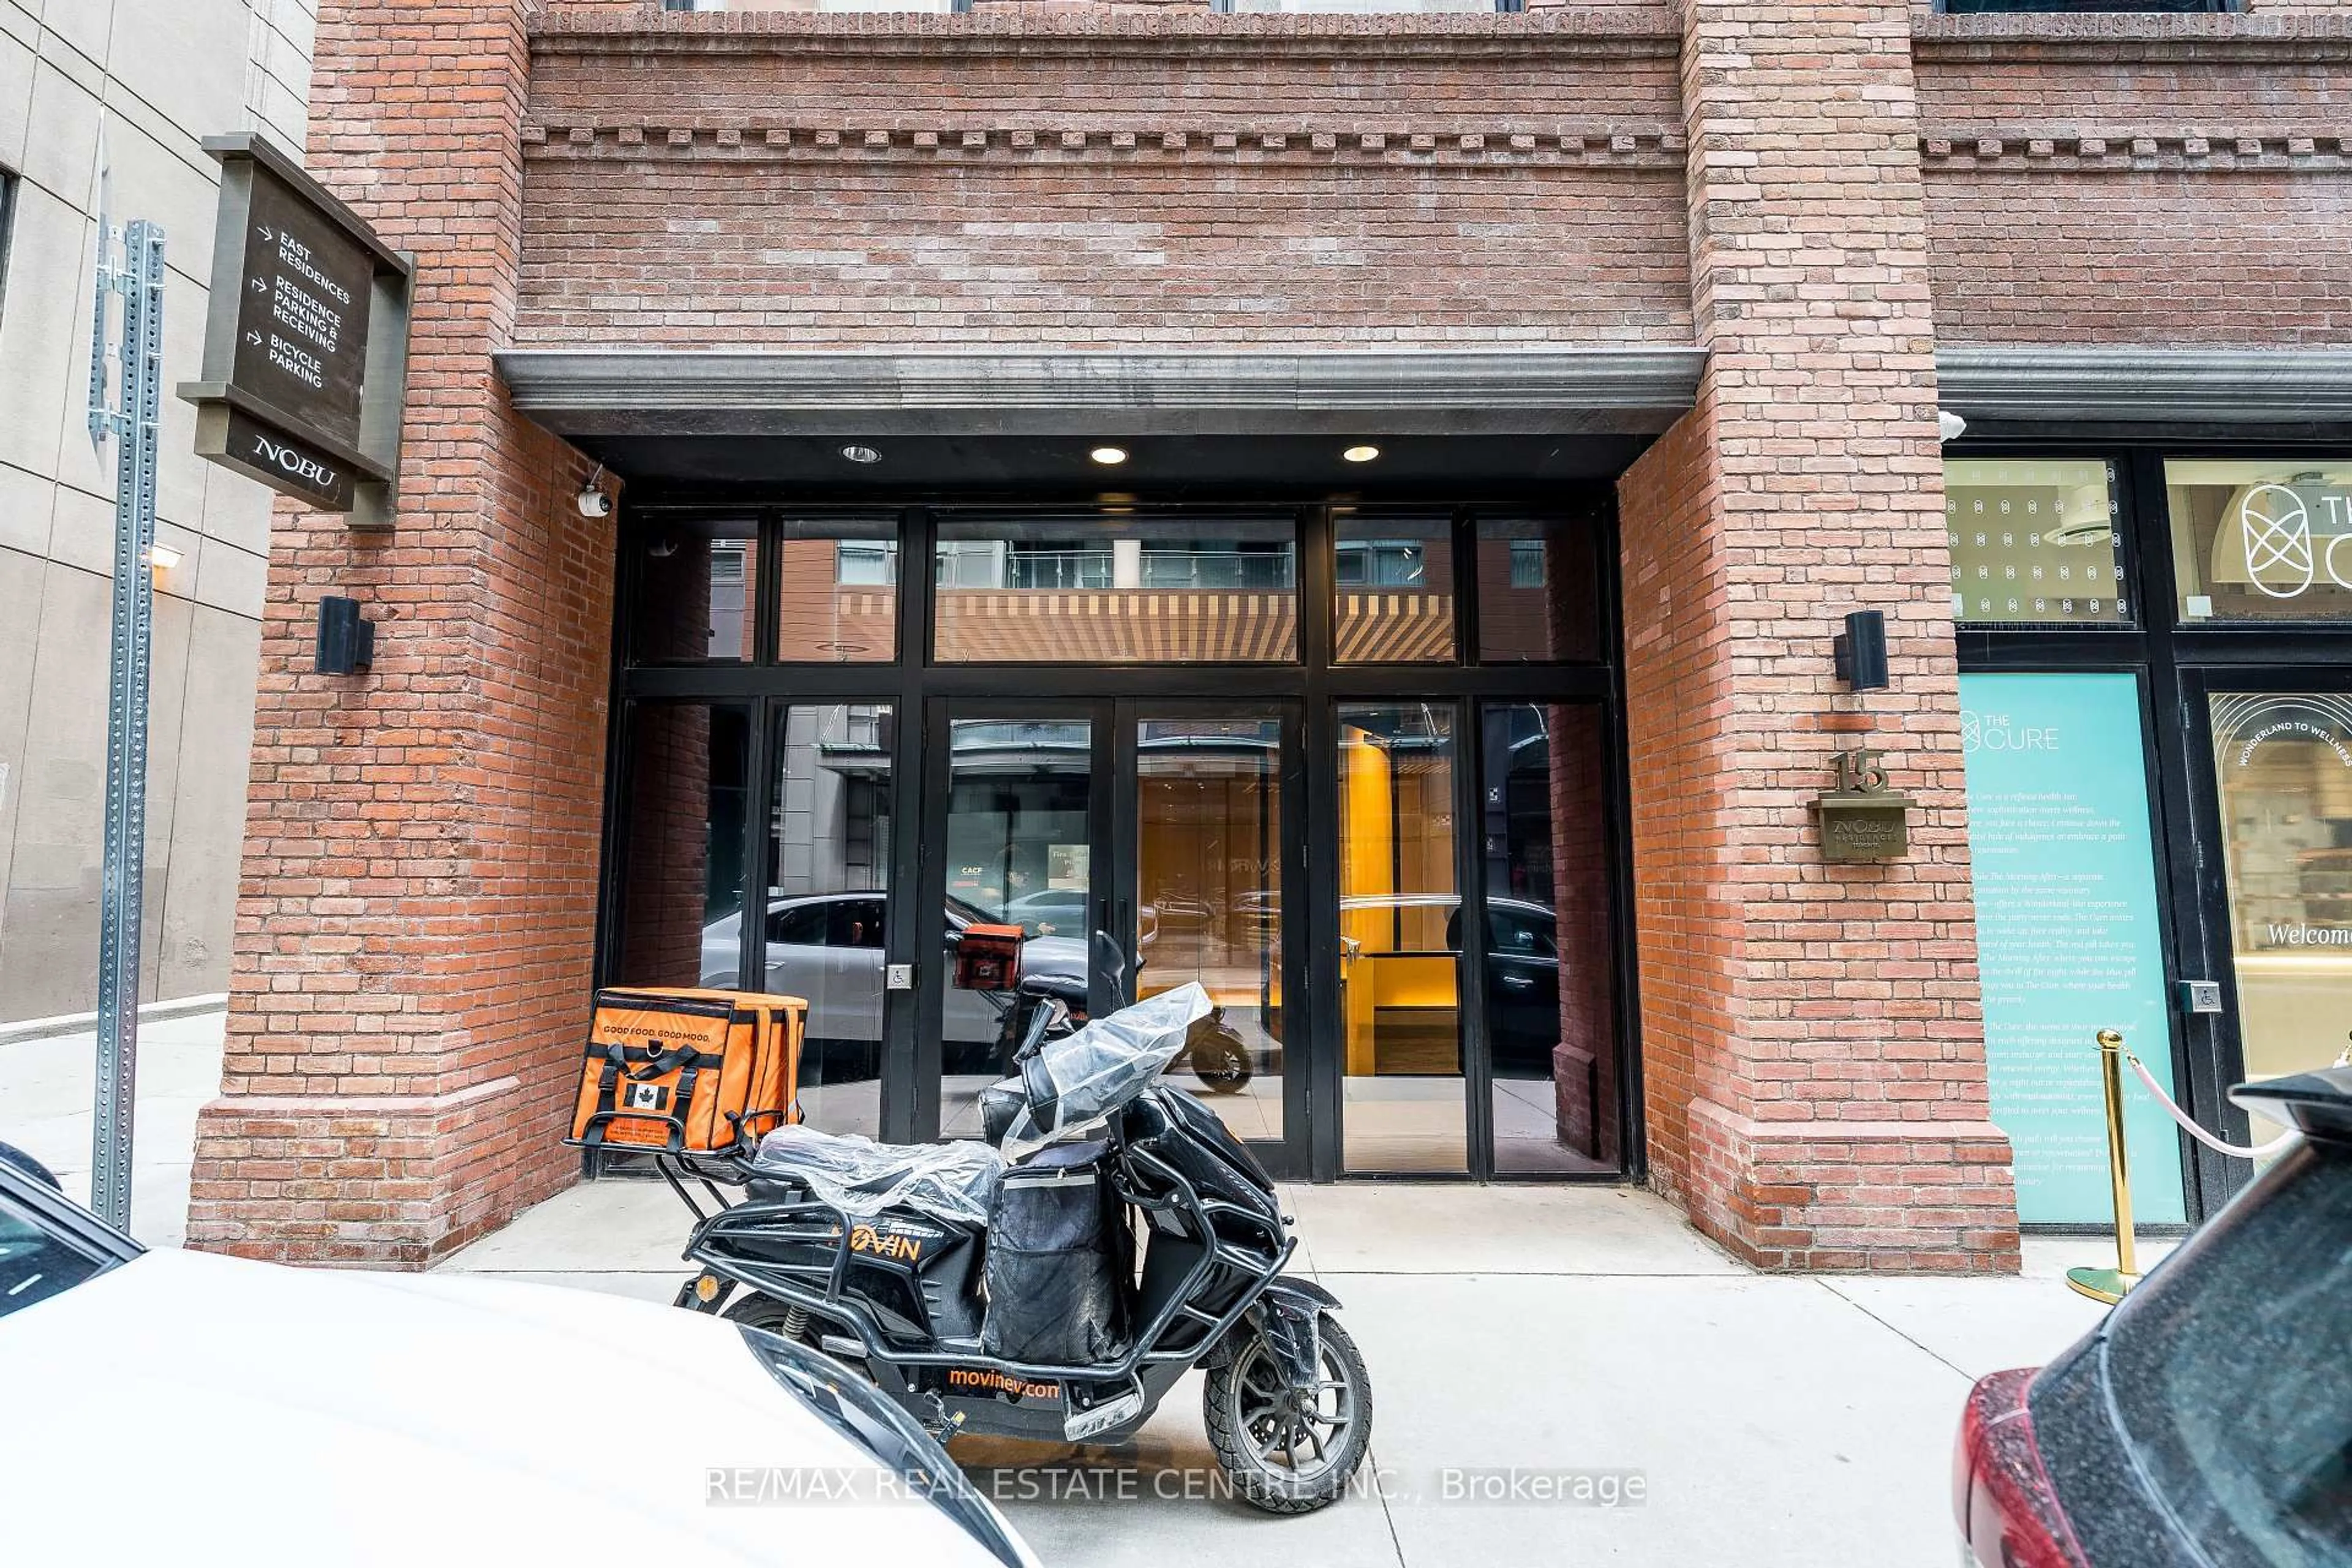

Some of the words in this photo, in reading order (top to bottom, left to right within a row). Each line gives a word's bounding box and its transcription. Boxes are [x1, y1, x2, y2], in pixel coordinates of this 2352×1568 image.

[281, 232, 311, 261] EAST
[279, 246, 350, 305] RESIDENCES
[274, 290, 327, 332] PARKING
[329, 326, 338, 340] &
[276, 274, 341, 328] RESIDENCE
[273, 304, 336, 353] RECEIVING
[269, 349, 323, 388] PARKING
[271, 333, 322, 374] BICYCLE
[252, 434, 337, 488] NOBU
[1984, 715, 2010, 726] THE
[1984, 728, 2059, 750] CURE
[2239, 722, 2292, 766] WONDERLAND
[2294, 722, 2309, 731] TO
[2310, 725, 2352, 766] WELLNESS
[1828, 750, 1889, 794] 15
[603, 1026, 629, 1035] GOOD
[658, 1030, 682, 1039] GOOD
